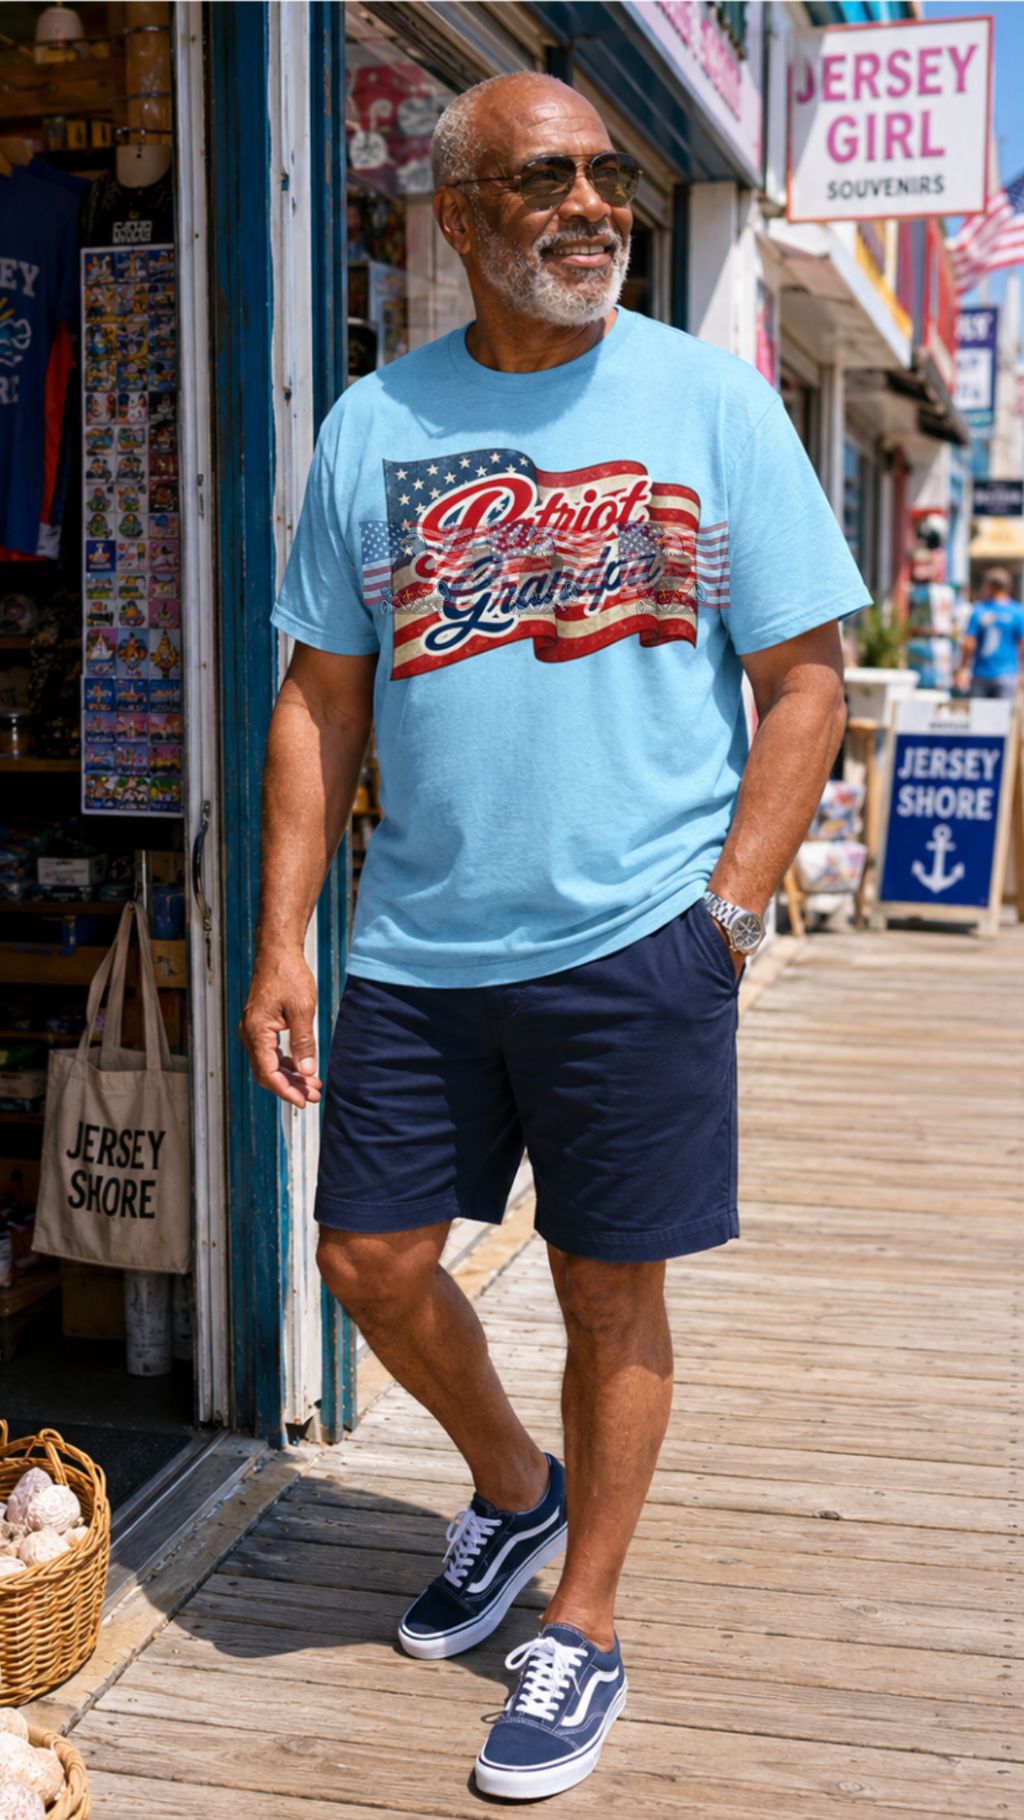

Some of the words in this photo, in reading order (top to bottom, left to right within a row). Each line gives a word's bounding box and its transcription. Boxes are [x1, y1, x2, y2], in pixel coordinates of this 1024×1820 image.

[796, 44, 978, 104] JERSEY
[826, 110, 945, 164] GIRL
[827, 174, 945, 201] SOUVENIRS
[413, 476, 652, 583] Patriot
[424, 545, 661, 652] Grandpa
[897, 746, 1001, 781] JERSEY
[896, 784, 994, 821] SHORE
[66, 1121, 166, 1170] JERSEY
[67, 1169, 156, 1220] SHORE
